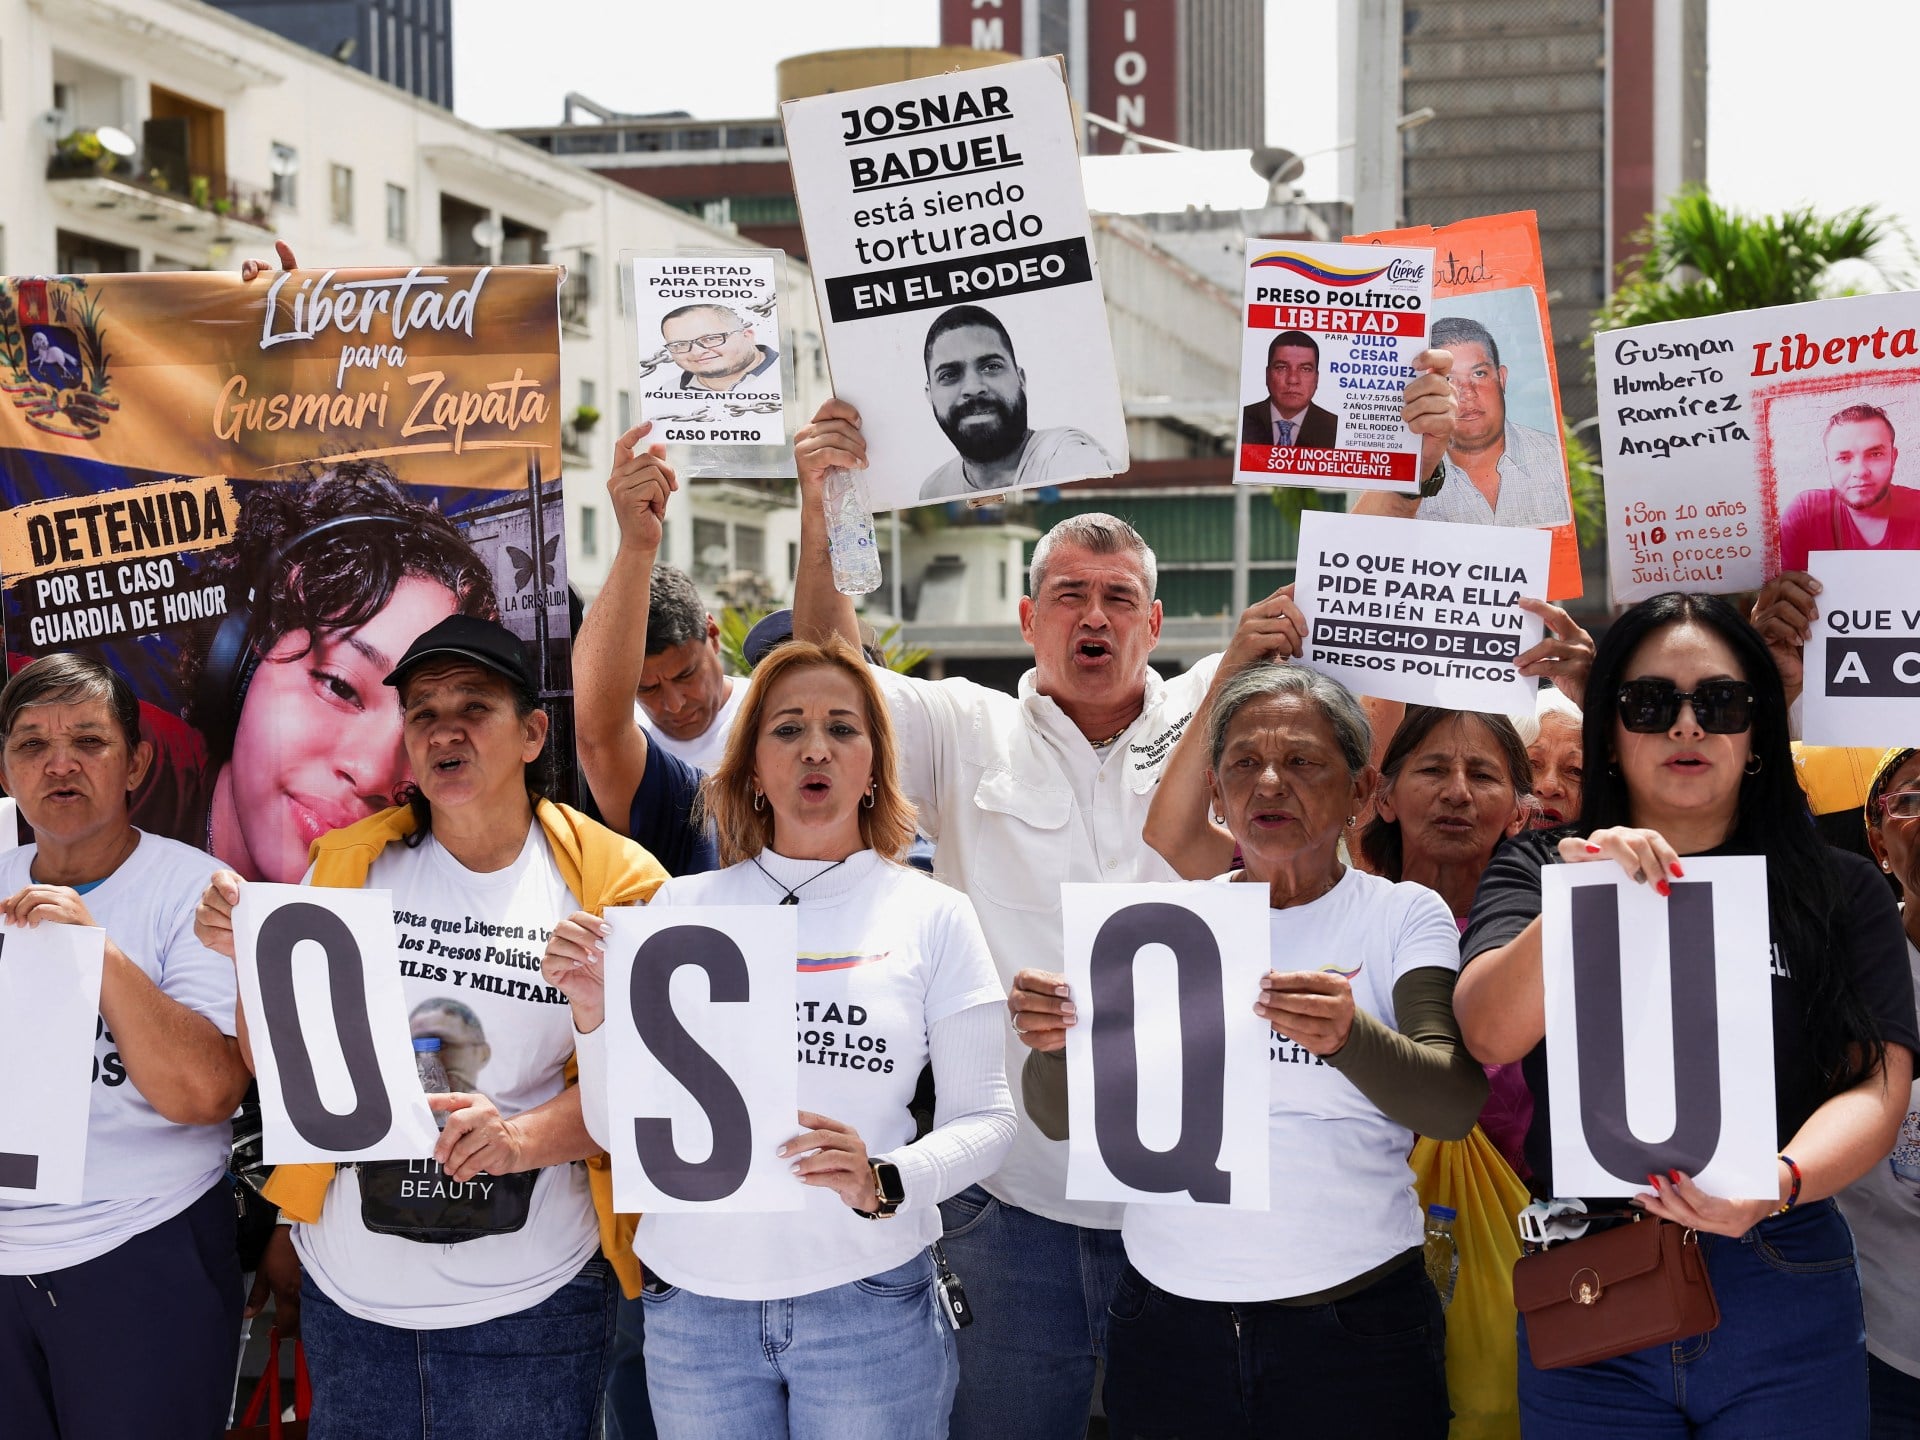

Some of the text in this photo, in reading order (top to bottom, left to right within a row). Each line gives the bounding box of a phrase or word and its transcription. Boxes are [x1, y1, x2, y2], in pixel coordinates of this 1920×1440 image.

[841, 85, 1011, 141] JOSNAR
[850, 134, 1022, 188] BADUEL
[853, 180, 1025, 228] está siendo
[854, 209, 1044, 265] torturado
[649, 277, 766, 287] PARA DENYS
[661, 266, 752, 275] LIBERTAD
[852, 254, 1066, 310] EN EL RODEO
[658, 289, 758, 299] CUSTODIO.
[1256, 287, 1421, 310] PRESO POLÍTICO
[260, 267, 493, 350] Libertad
[1274, 307, 1399, 333] LIBERTAD
[1325, 333, 1397, 347] PARA JULIO
[1615, 338, 1734, 366] Gusman
[337, 342, 407, 389] para
[1349, 349, 1398, 362] CESAR
[1330, 362, 1417, 378] RODRIGUEZ
[644, 391, 781, 401] #QUESEANTODOS
[1339, 377, 1406, 391] SALAZAR
[1349, 402, 1372, 410] AÑOS
[1360, 394, 1405, 402] V-7.575.65
[213, 368, 551, 454] Gusmari Zapata
[1362, 413, 1402, 422] LIBERTAD
[665, 429, 761, 441] CASO POTRO
[1354, 432, 1376, 440] DESDE
[1369, 424, 1398, 432] RODEO
[1270, 447, 1390, 465] SOY INOCENTE. NO
[1345, 440, 1386, 449] SEPTIEMBRE
[1267, 458, 1392, 477] SOY UN DELICUENTE
[1675, 504, 1697, 520] 10
[1706, 501, 1747, 517] años
[27, 486, 228, 567] DETENIDA
[1675, 522, 1748, 541] meses
[1319, 551, 1528, 584] LO QUE HOY CILIA
[1673, 546, 1752, 568] proceso
[36, 558, 175, 609] POR EL CASO
[1317, 574, 1522, 608] PIDE PARA ELLA
[30, 584, 228, 647] GUARDIA DE HONOR
[505, 596, 517, 612] LA
[1317, 598, 1524, 630] TAMBIÉN ERA UN
[1827, 610, 1892, 634] QUE
[1316, 624, 1517, 658] DERECHO DE LOS
[1312, 650, 1516, 683] PRESOS POLÍTICOS
[1833, 651, 1871, 684] A
[431, 918, 462, 935] que
[465, 916, 524, 940] Liberen
[528, 929, 537, 941] a
[398, 934, 424, 951] los
[427, 939, 481, 962] Presos
[453, 970, 467, 986] Y
[256, 902, 393, 1152] O
[1571, 881, 1721, 1185] U
[845, 1033, 887, 1054] LOS
[1090, 902, 1231, 1204] Q
[630, 925, 752, 1202] S
[401, 1180, 494, 1200] BEAUTY
